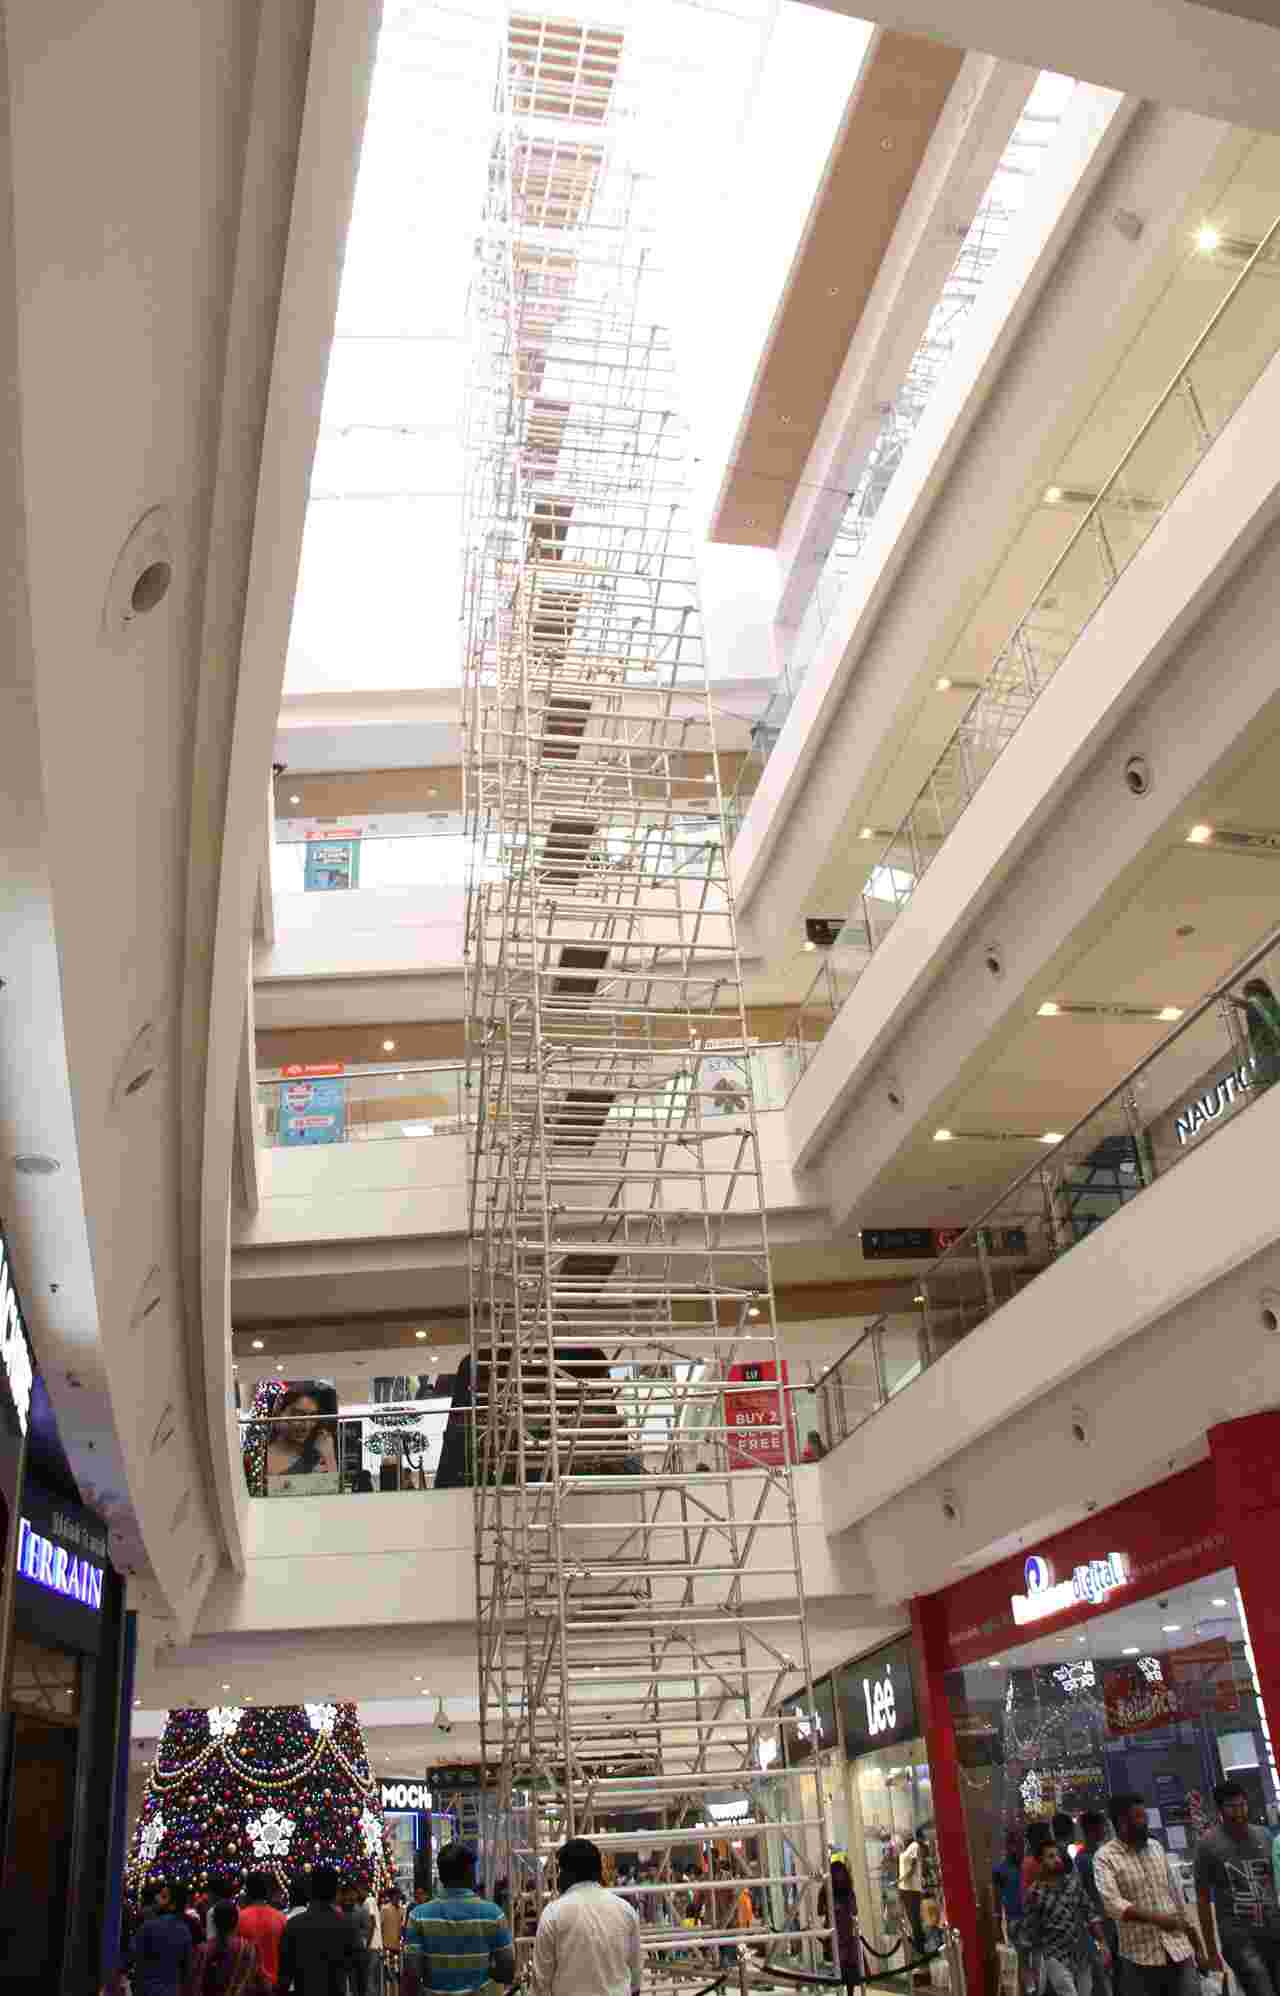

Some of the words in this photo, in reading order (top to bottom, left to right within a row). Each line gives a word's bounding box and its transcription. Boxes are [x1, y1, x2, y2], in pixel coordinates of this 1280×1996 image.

[735, 1411, 765, 1425] BUY
[738, 1438, 781, 1449] FREE
[17, 1517, 104, 1609] TERRAIN
[863, 1678, 897, 1736] Lee
